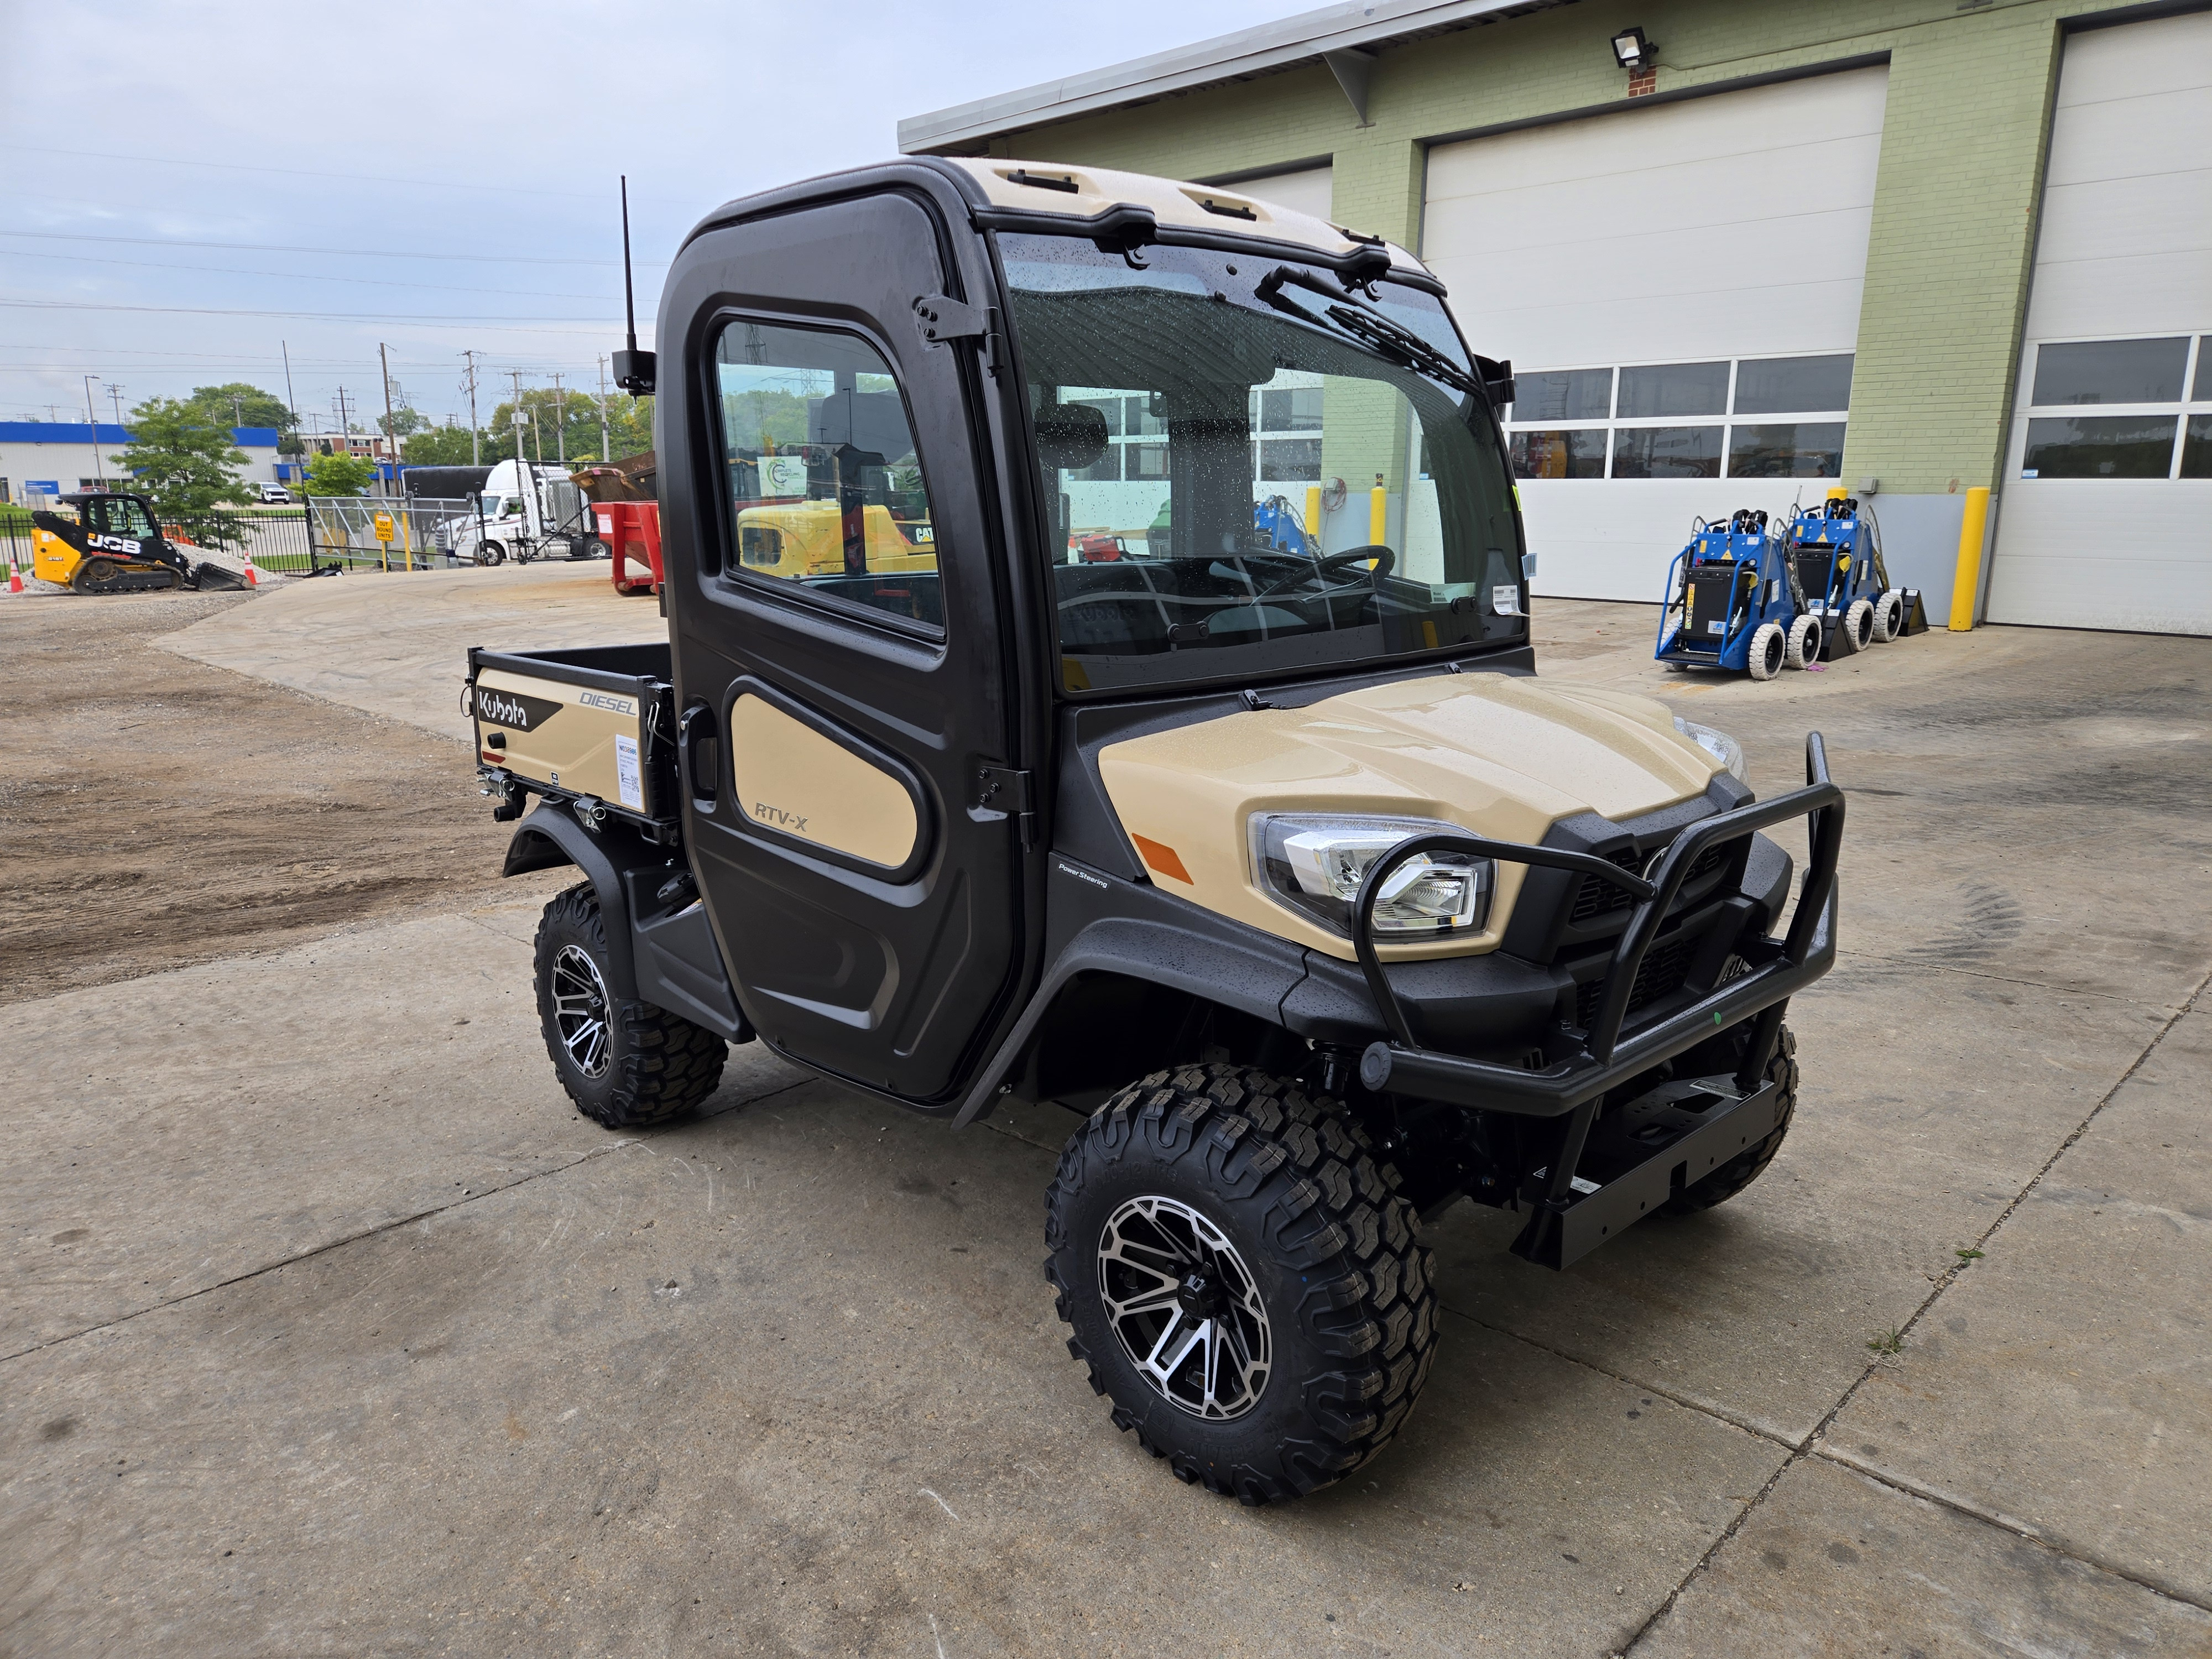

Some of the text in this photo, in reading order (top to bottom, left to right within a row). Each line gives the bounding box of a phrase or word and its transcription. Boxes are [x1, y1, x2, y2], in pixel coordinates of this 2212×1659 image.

[87, 534, 141, 554] JCB
[916, 527, 934, 542] CAT
[479, 691, 527, 726] Kubota
[580, 692, 636, 716] DIESEL
[755, 802, 808, 832] RTV-X
[1058, 863, 1108, 888] Power Steering
